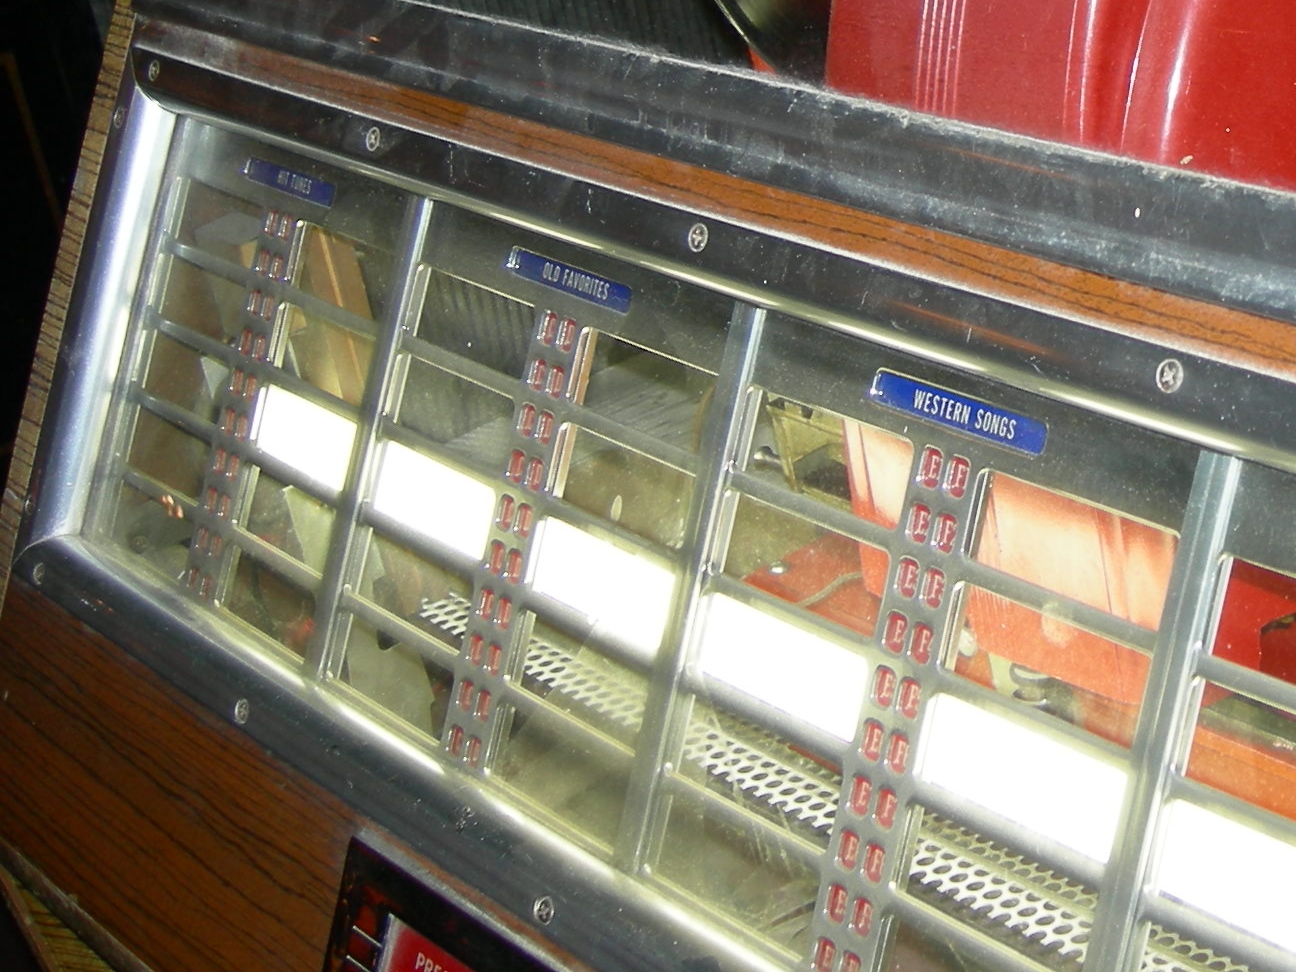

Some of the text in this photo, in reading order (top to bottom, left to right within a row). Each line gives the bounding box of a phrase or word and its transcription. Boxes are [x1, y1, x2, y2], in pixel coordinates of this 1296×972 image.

[542, 261, 610, 301] OLD FAVORITES
[913, 388, 1017, 440] WESTERN SONGS
